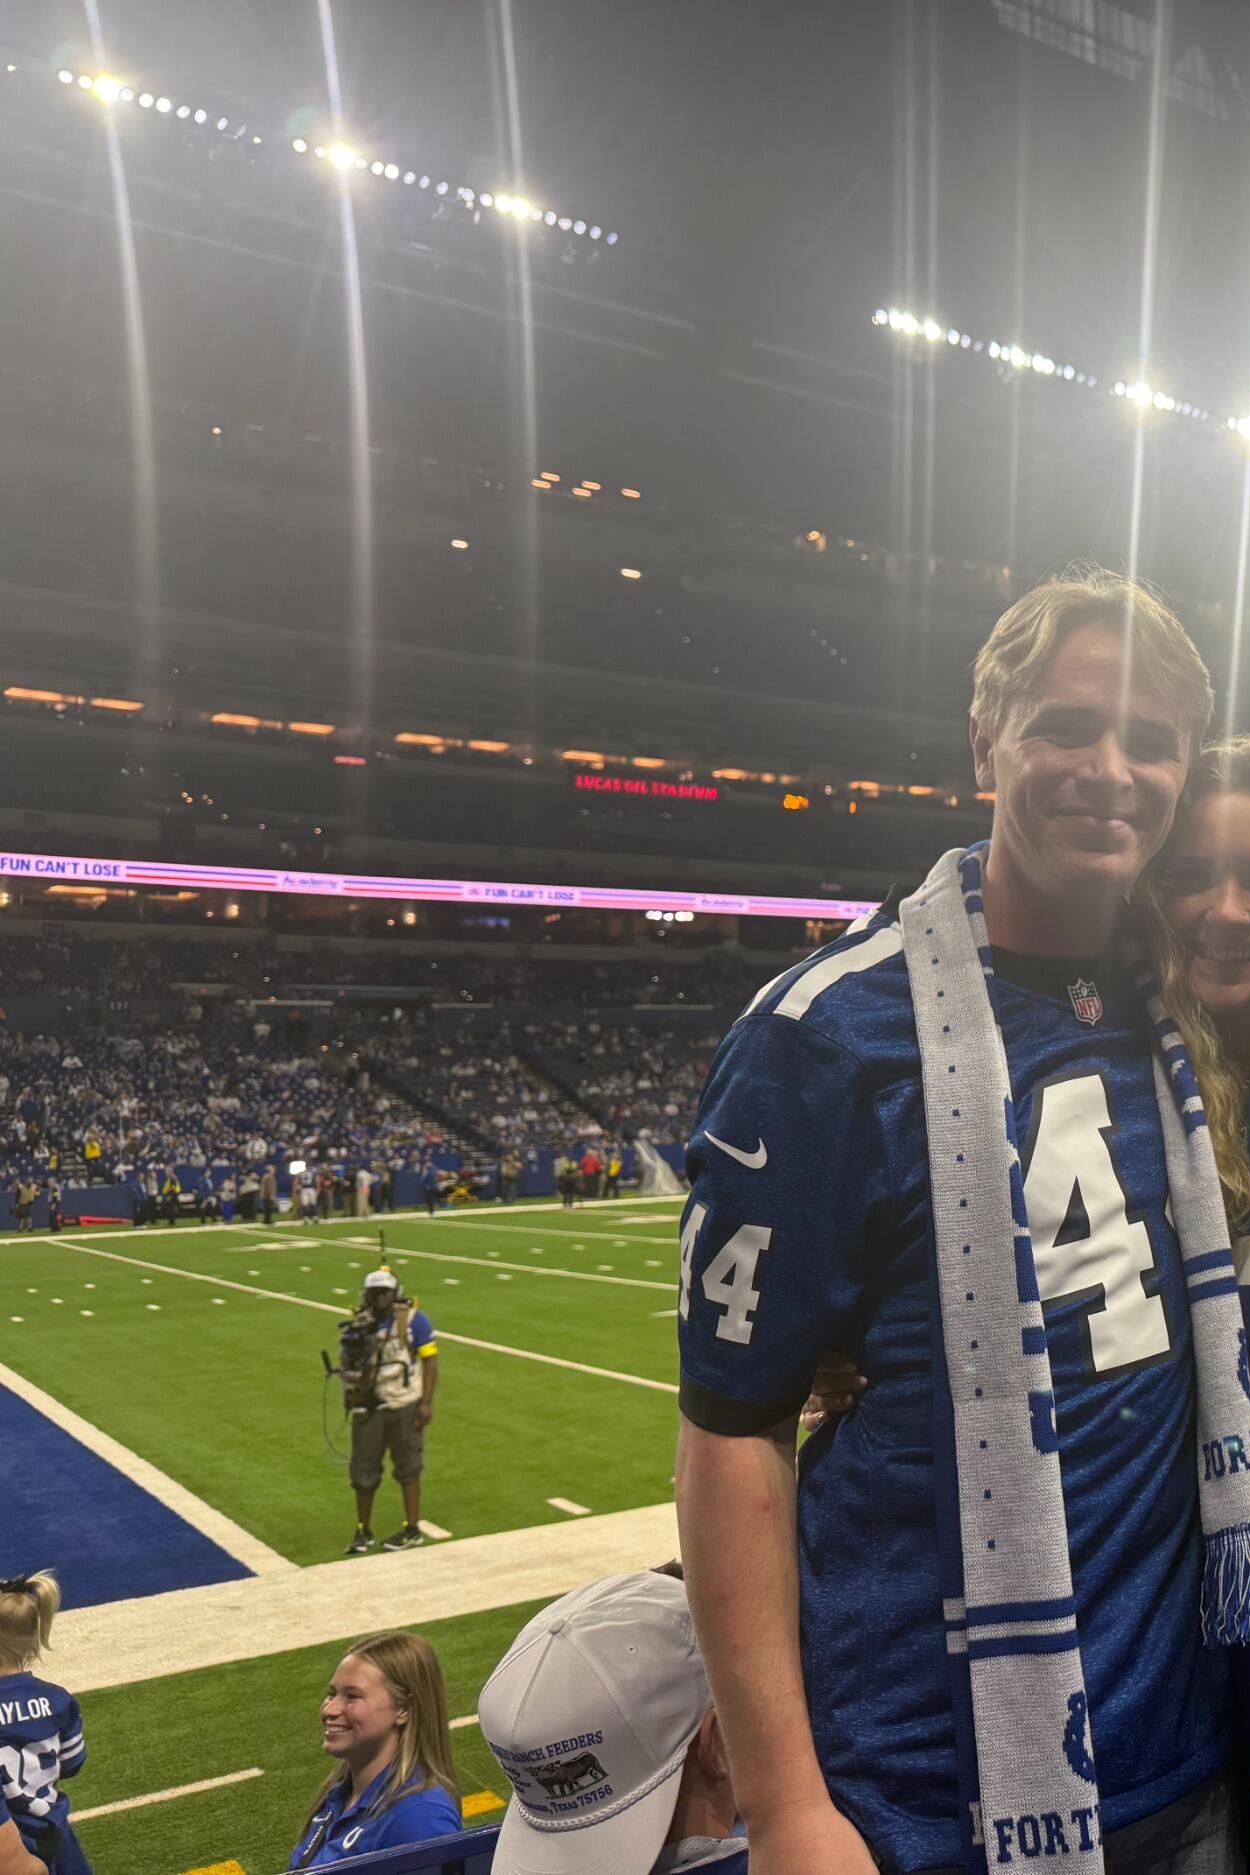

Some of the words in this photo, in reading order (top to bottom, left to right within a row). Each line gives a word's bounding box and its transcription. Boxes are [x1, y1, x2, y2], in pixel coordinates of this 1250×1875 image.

[575, 775, 621, 793] LUCAS
[623, 779, 648, 795] OIL
[0, 857, 31, 871] FUN
[35, 860, 80, 875] CAN'T
[84, 863, 121, 877] LOSE
[546, 1730, 604, 1758] FEEDERS
[994, 1811, 1069, 1864] FOR
